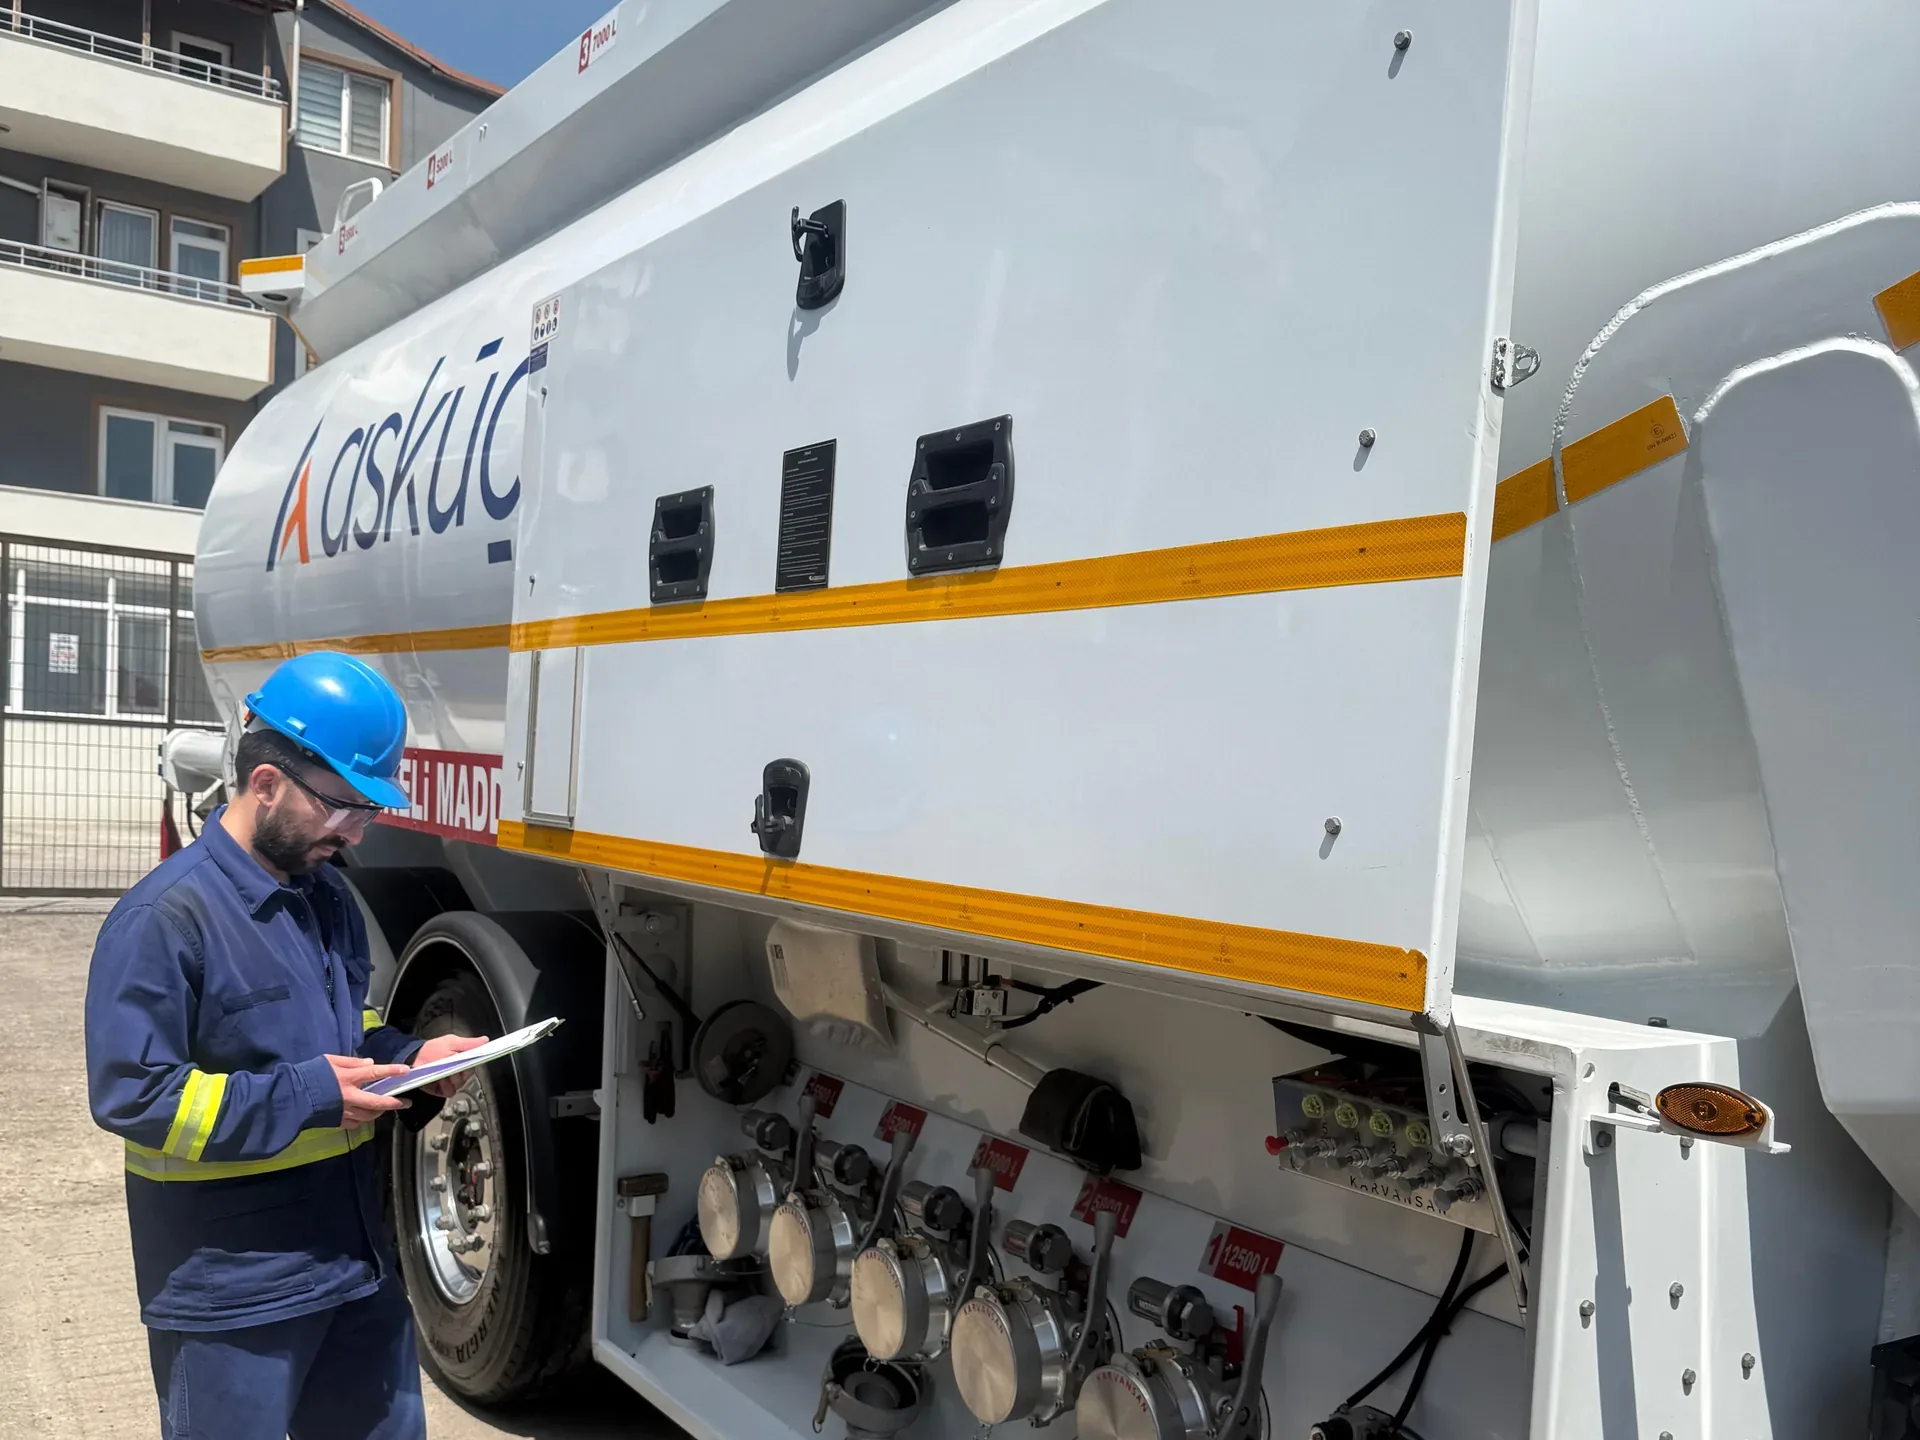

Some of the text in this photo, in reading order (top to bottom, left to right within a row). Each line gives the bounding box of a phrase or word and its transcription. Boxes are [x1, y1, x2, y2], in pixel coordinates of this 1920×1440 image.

[611, 19, 617, 37] L
[1321, 1122, 1328, 1135] 5
[1355, 1131, 1361, 1144] 4
[1390, 1142, 1397, 1154] 3
[1426, 1151, 1434, 1164] 2
[1120, 1204, 1130, 1224] L
[1208, 1233, 1223, 1266] 1
[1223, 1244, 1261, 1275] 12500
[963, 1302, 1004, 1335] KARVANSAN
